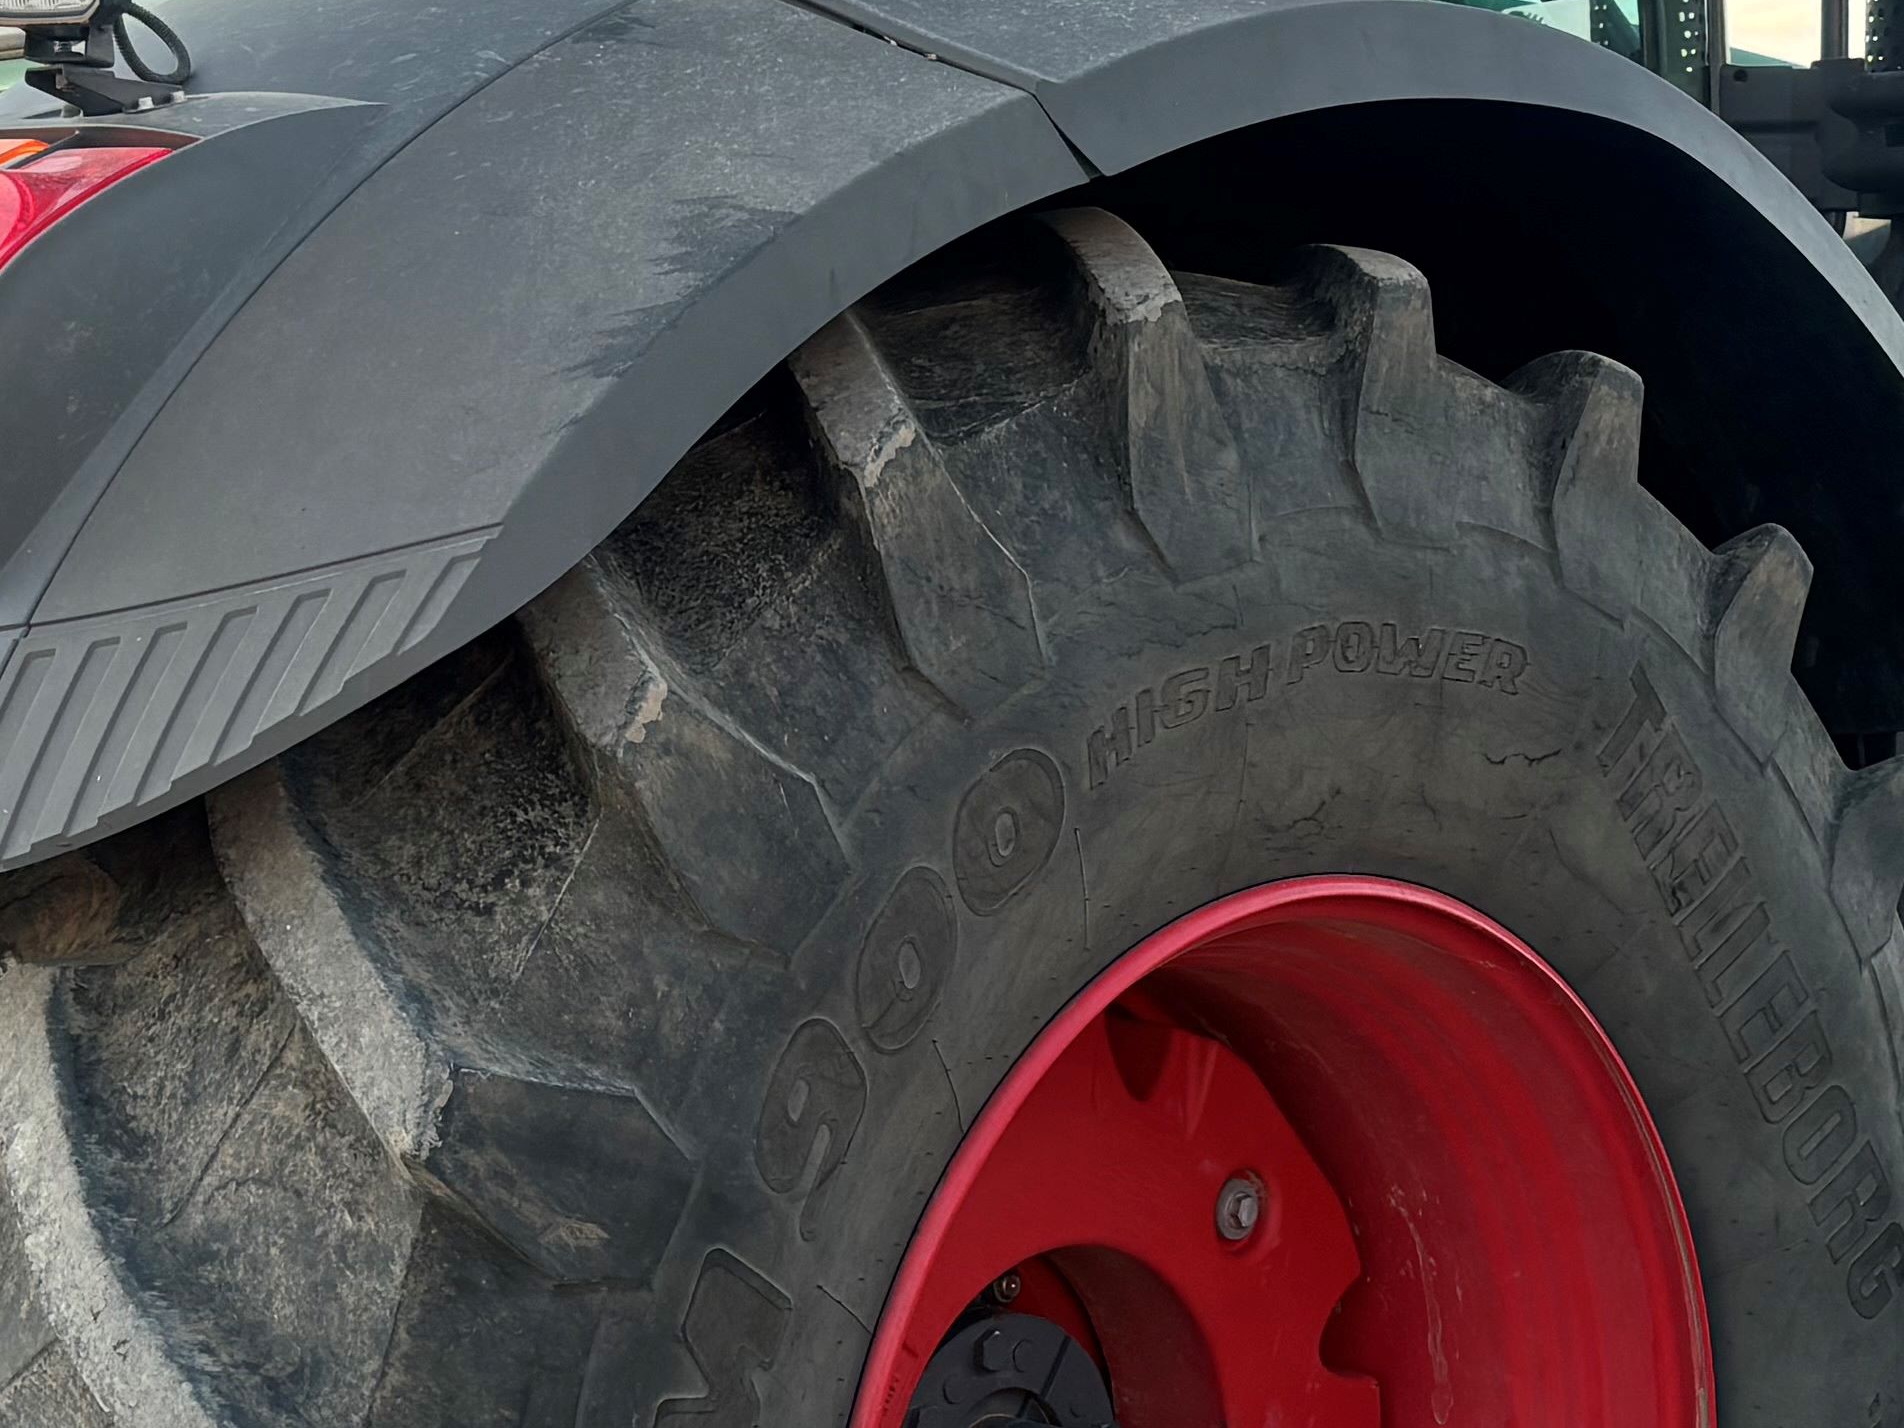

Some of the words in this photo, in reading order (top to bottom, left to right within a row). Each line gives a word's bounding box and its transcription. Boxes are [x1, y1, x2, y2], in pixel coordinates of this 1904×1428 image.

[1086, 644, 1274, 792] HIGH
[1285, 619, 1532, 698] POWER
[754, 746, 1067, 1243] 900
